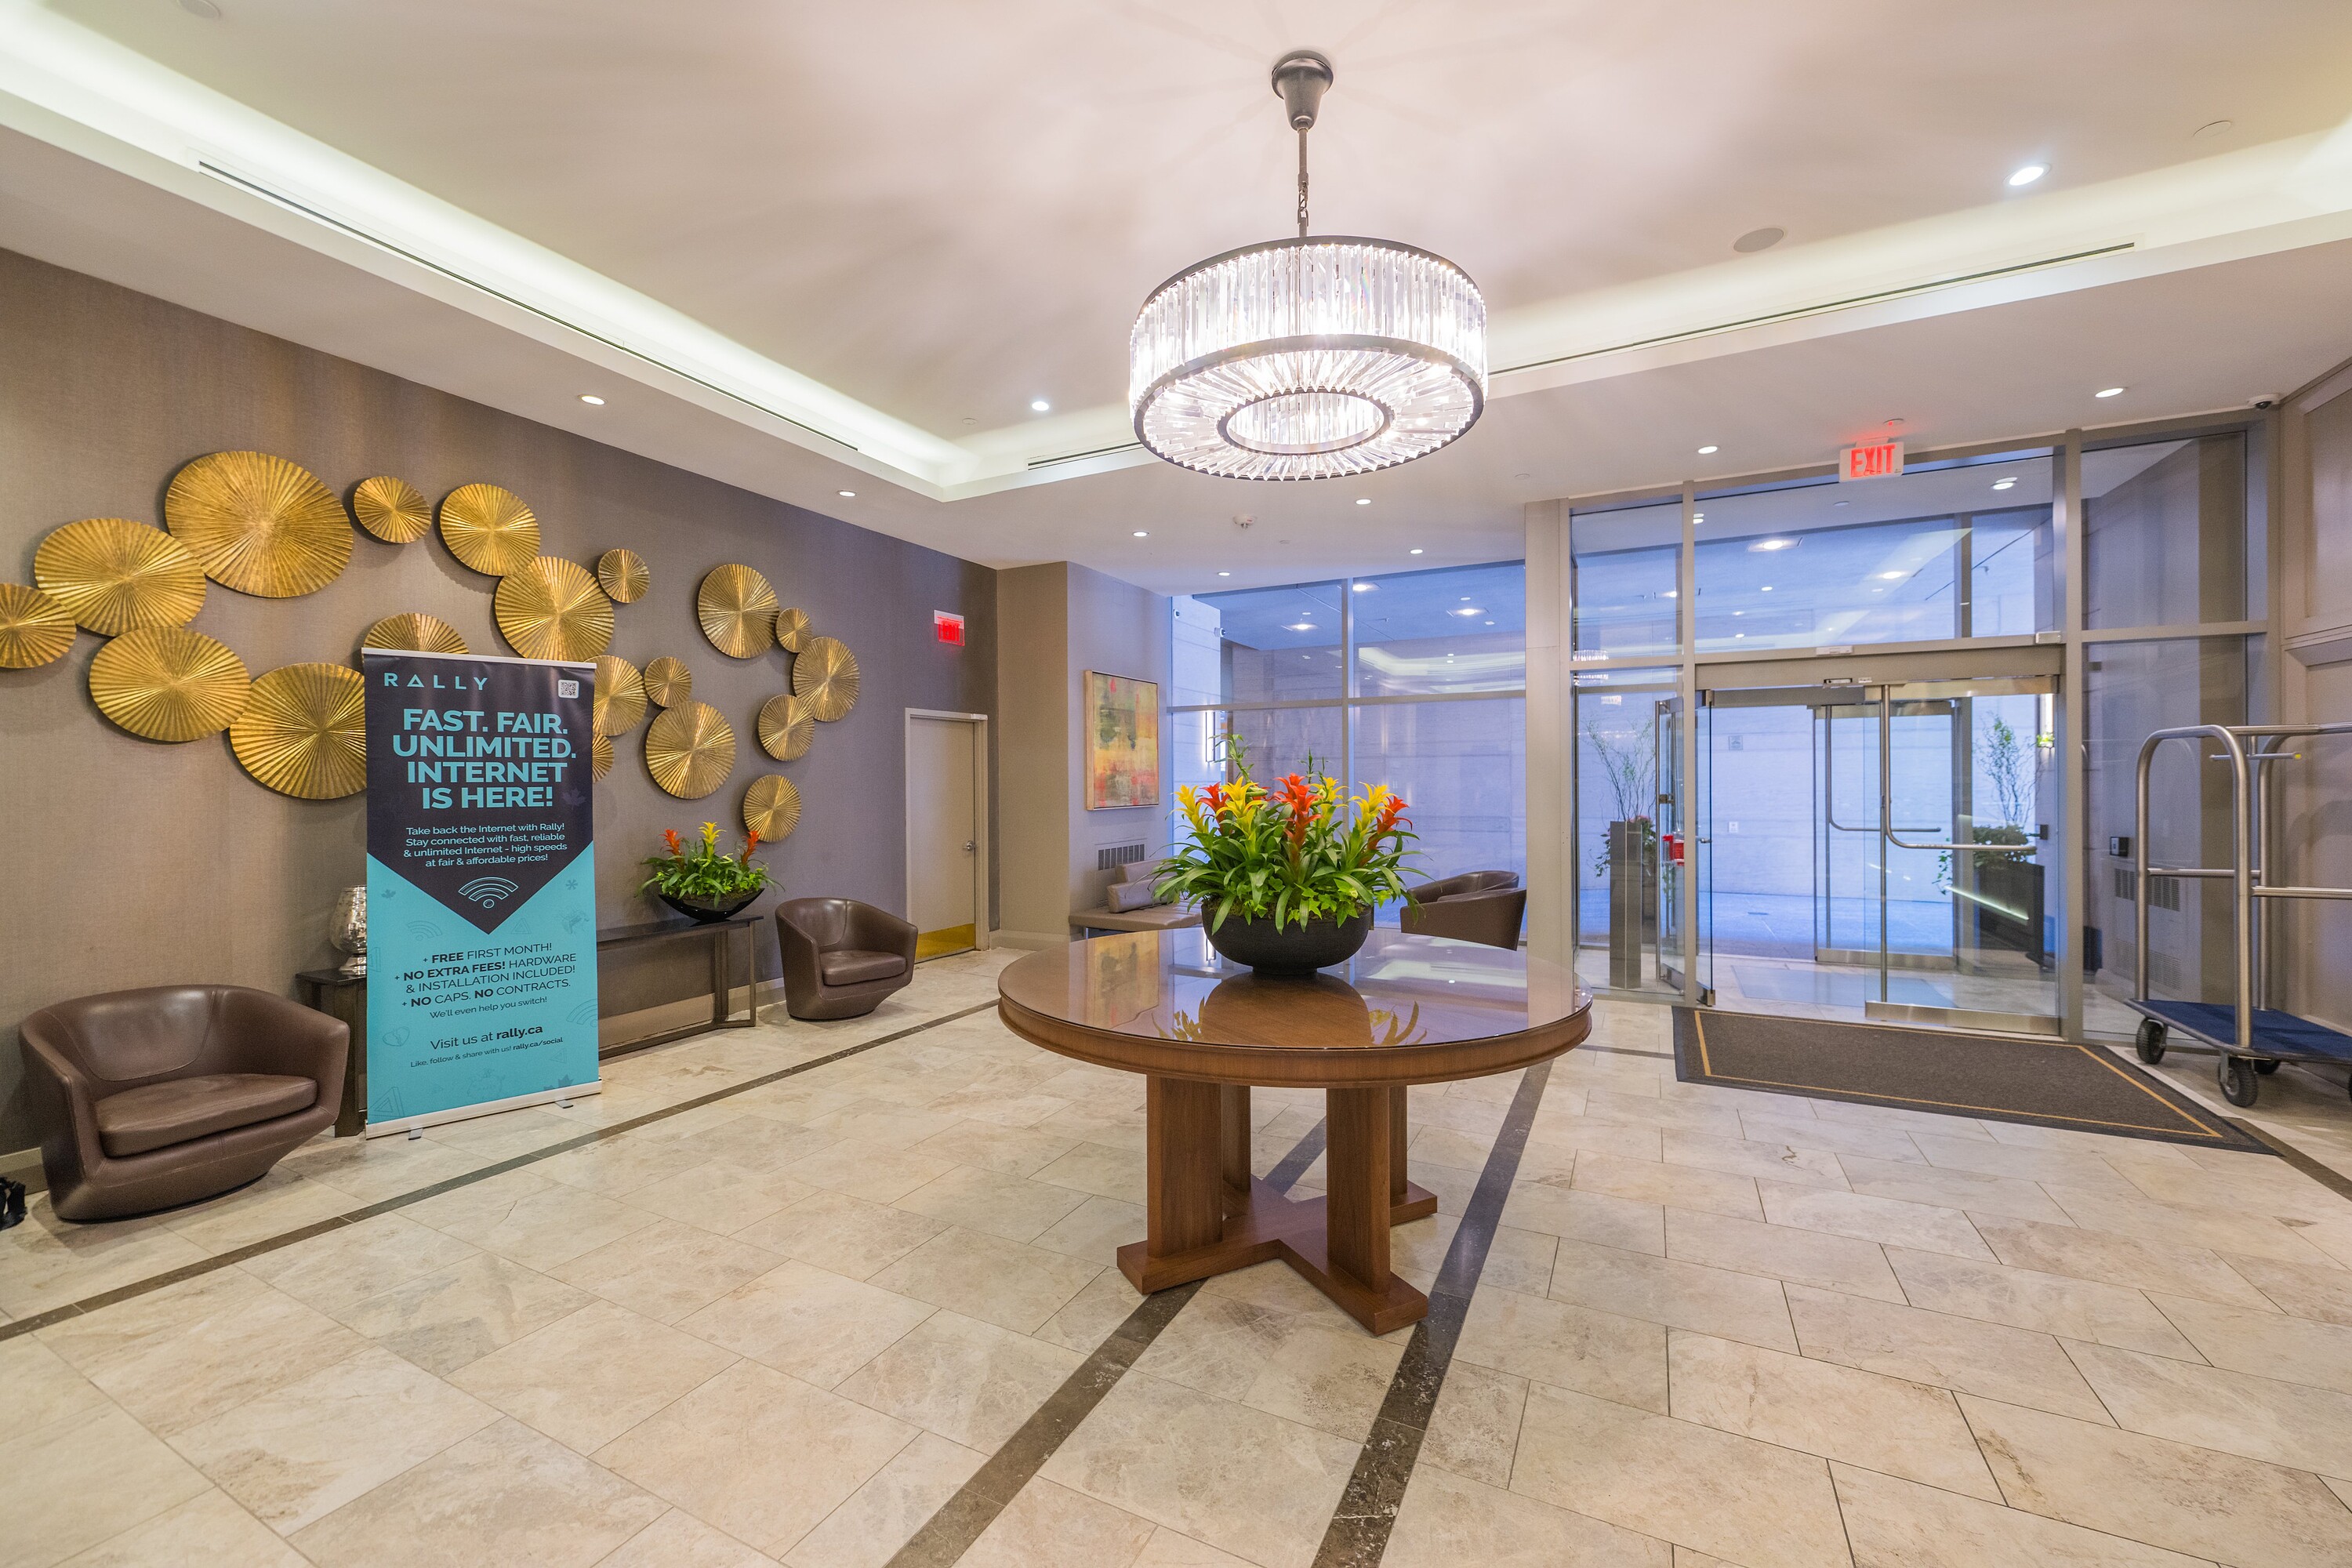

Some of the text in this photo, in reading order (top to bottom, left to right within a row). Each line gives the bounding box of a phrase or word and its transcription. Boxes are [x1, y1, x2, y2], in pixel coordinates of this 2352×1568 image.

[1850, 444, 1896, 477] EXIT
[383, 673, 488, 691] RALLY
[403, 708, 568, 735] FAST. FAIR.
[392, 735, 576, 758] UNLIMITED.
[407, 761, 568, 783] INTERNET
[423, 786, 553, 809] IS HERE!
[405, 837, 429, 848] Stay
[430, 835, 485, 845] connected
[531, 833, 565, 841] reliable
[406, 827, 431, 836] Take
[433, 826, 458, 834] back
[459, 825, 477, 833] the
[478, 824, 516, 833] Internet
[539, 822, 564, 832] Rally!
[414, 847, 463, 857] unlimited
[464, 845, 503, 855] Internet
[511, 844, 532, 854] high
[533, 843, 568, 853] speeds
[425, 858, 436, 867] at
[438, 857, 454, 866] fair
[466, 855, 516, 865] affordable
[517, 854, 548, 863] prices!
[431, 952, 464, 964] FREE
[466, 947, 502, 960] FIRST
[504, 942, 553, 956] MONTH!
[403, 970, 424, 982] NO
[427, 965, 468, 978] EXTRA
[472, 961, 506, 973] FEES!
[509, 953, 576, 969] HARDWARE
[406, 964, 575, 993] & INSTALLATION INCLUDED!
[411, 996, 431, 1007] NO
[434, 991, 471, 1004] CAPS.
[474, 988, 494, 999] NO
[496, 978, 571, 996] CONTRACTS.
[430, 996, 547, 1019] We'll even help you switch!
[430, 1025, 543, 1050] Visit us at rally.ca
[430, 1056, 454, 1065] follow
[462, 1050, 483, 1059] share
[513, 1036, 564, 1051] rally.ca/social
